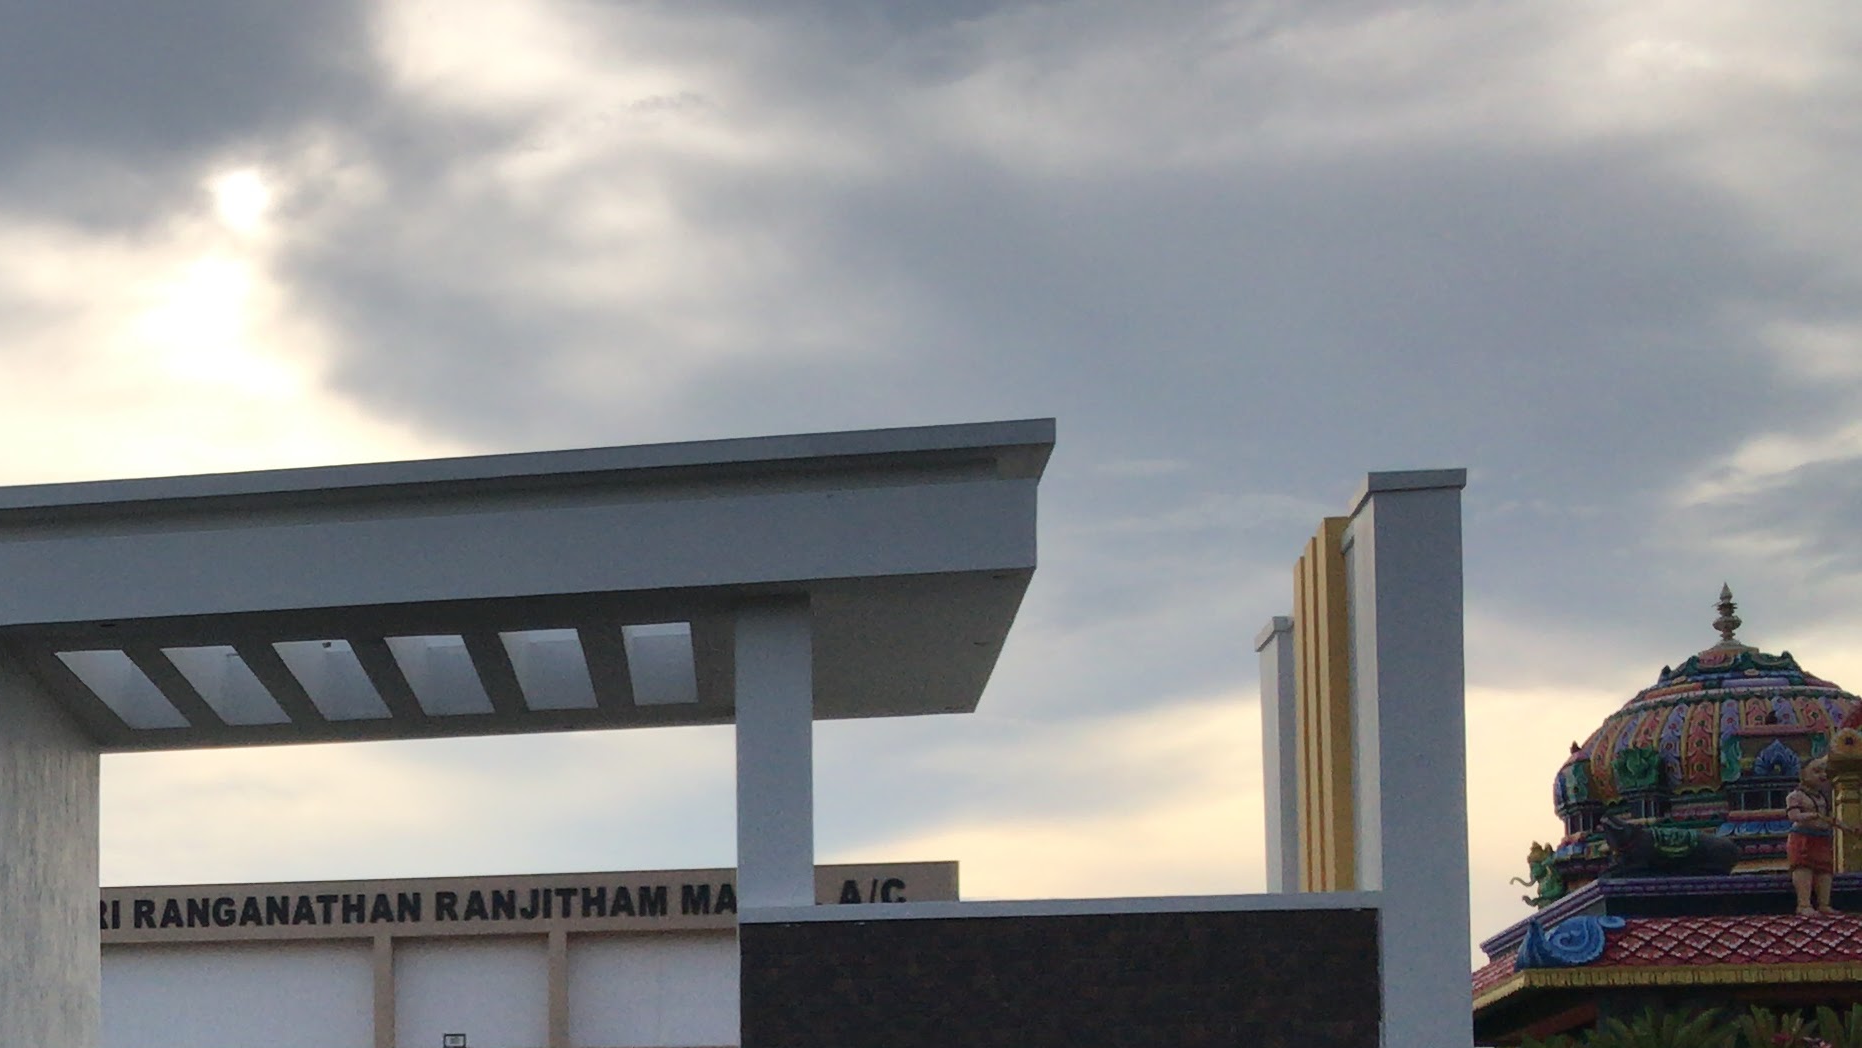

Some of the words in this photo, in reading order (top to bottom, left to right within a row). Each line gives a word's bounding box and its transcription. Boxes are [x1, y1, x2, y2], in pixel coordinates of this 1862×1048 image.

[134, 892, 421, 929] RANGANATHAN
[435, 885, 668, 921] RANJITHAM
[839, 878, 907, 904] A/C
